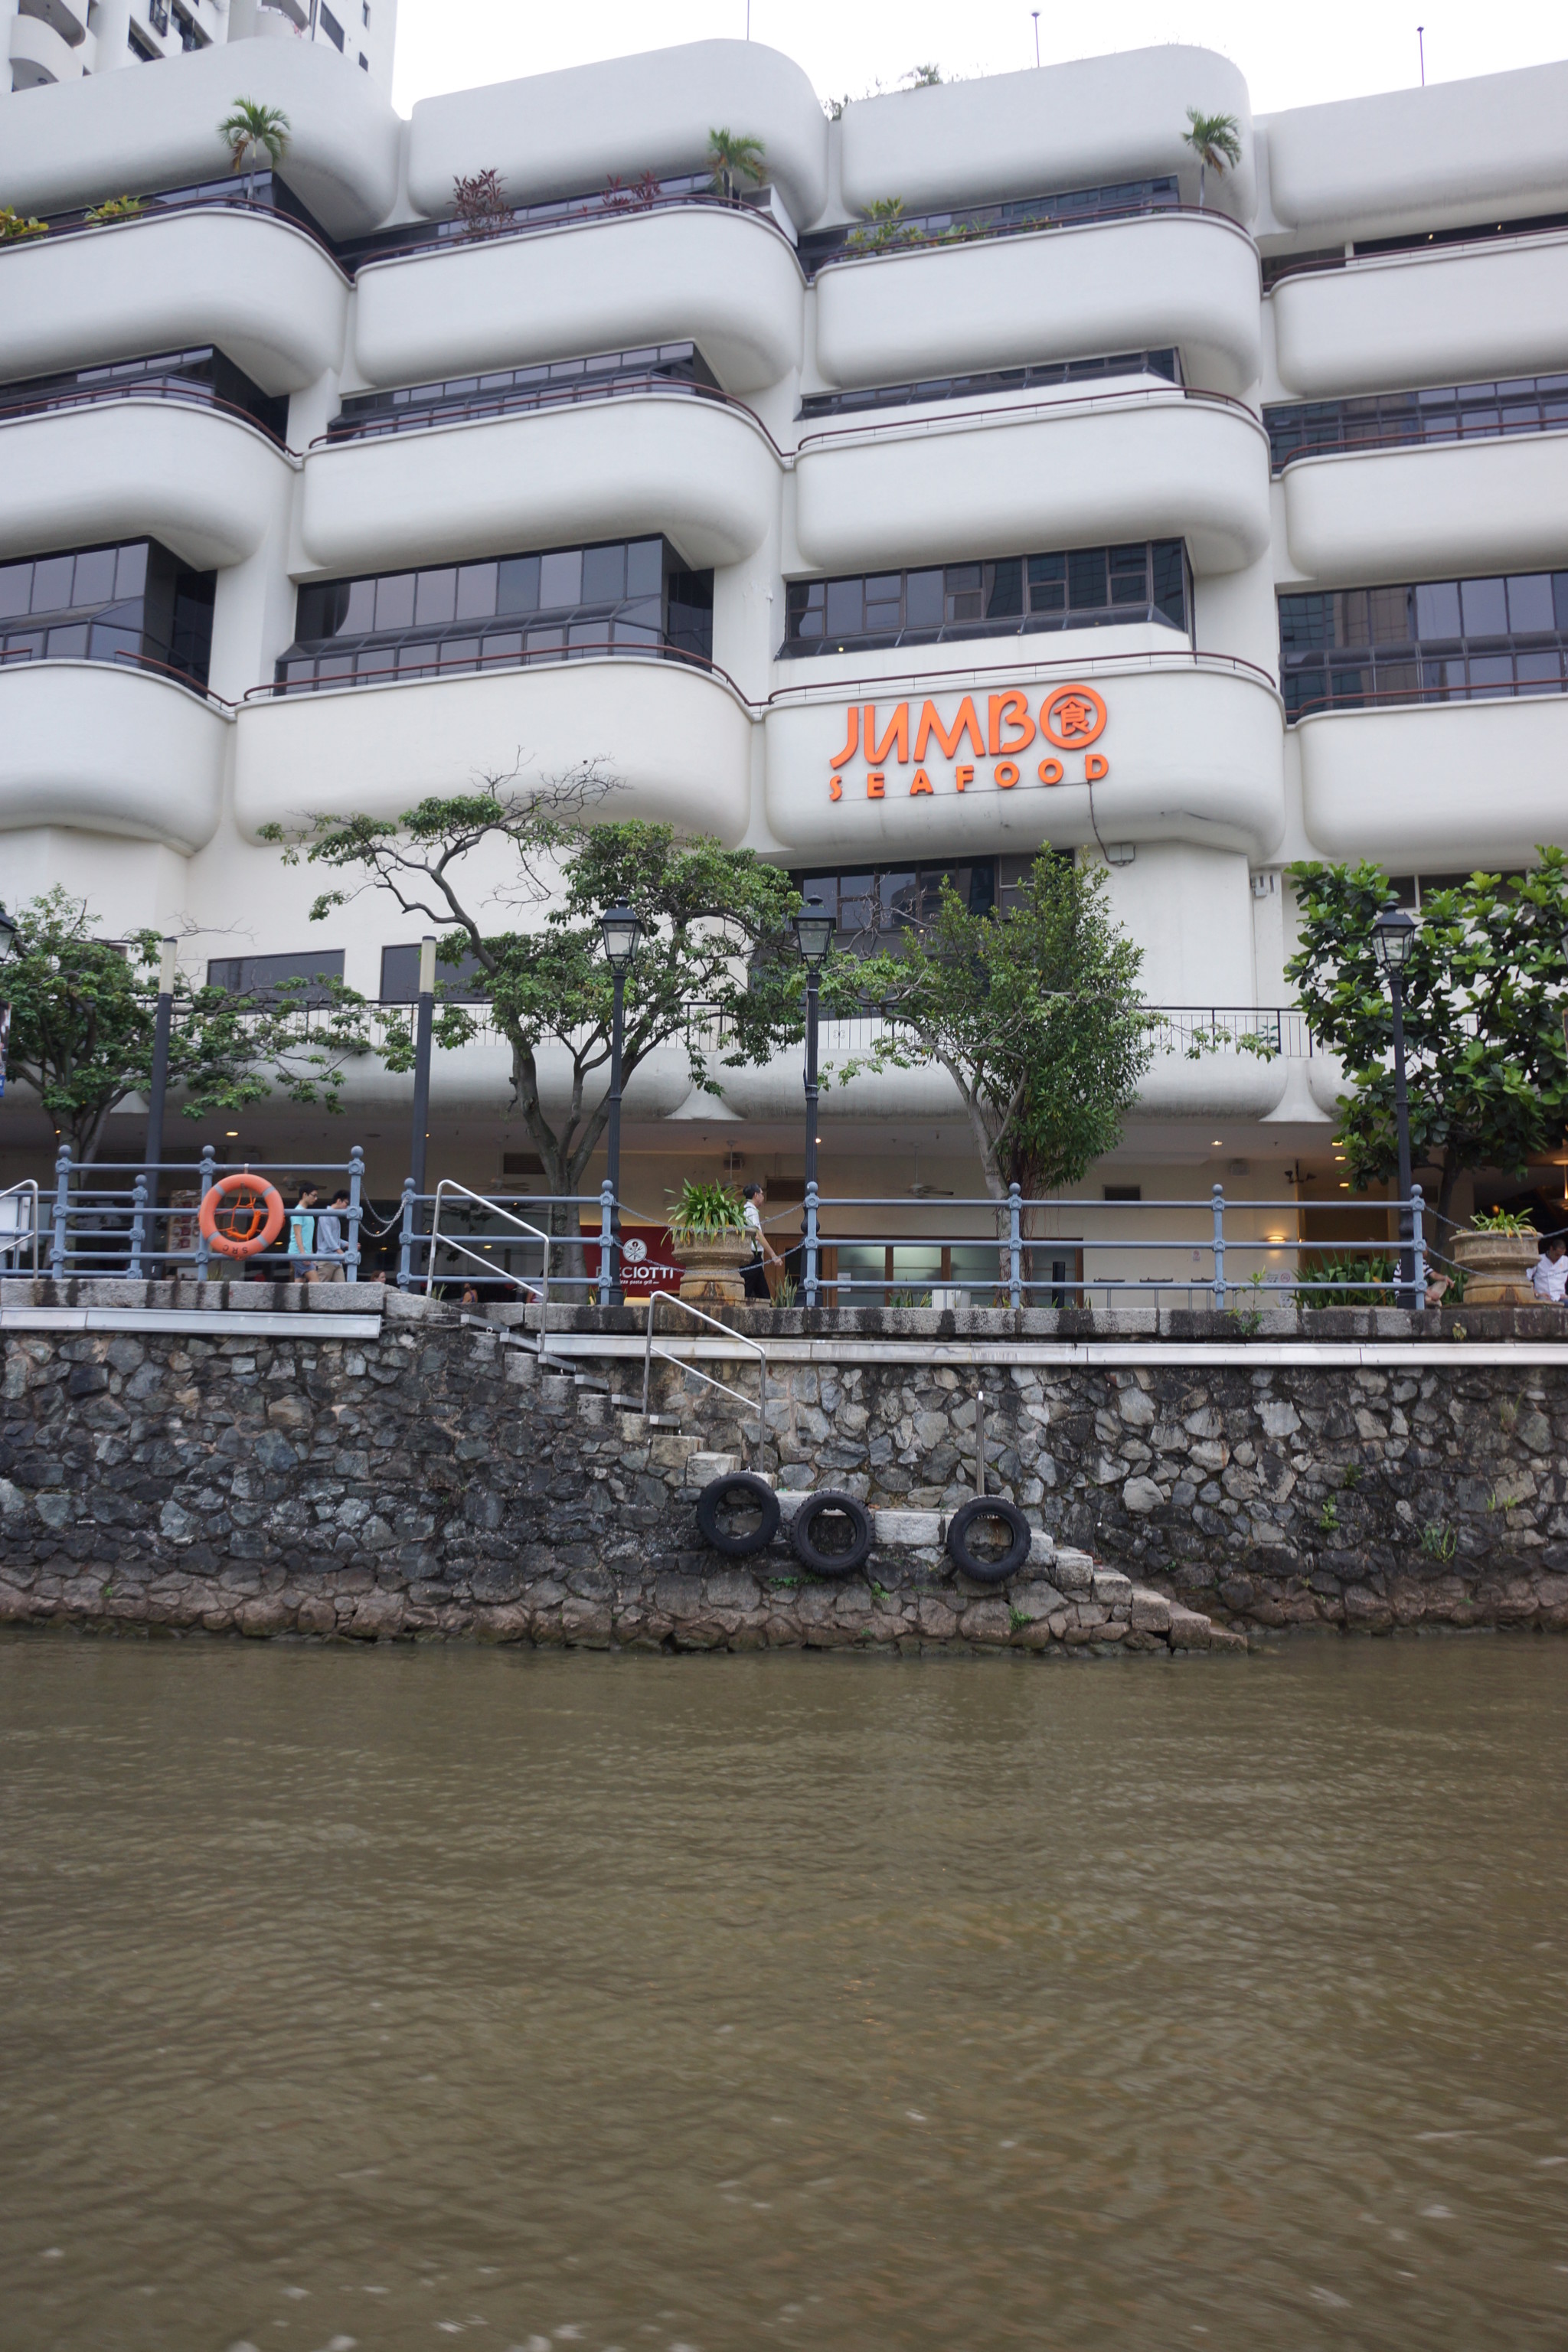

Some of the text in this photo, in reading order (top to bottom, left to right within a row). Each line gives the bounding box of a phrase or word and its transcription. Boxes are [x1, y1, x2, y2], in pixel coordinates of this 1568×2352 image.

[829, 754, 1109, 801] SEAFOOD
[223, 1244, 249, 1254] SRC
[596, 1266, 674, 1279] CIOTTI
